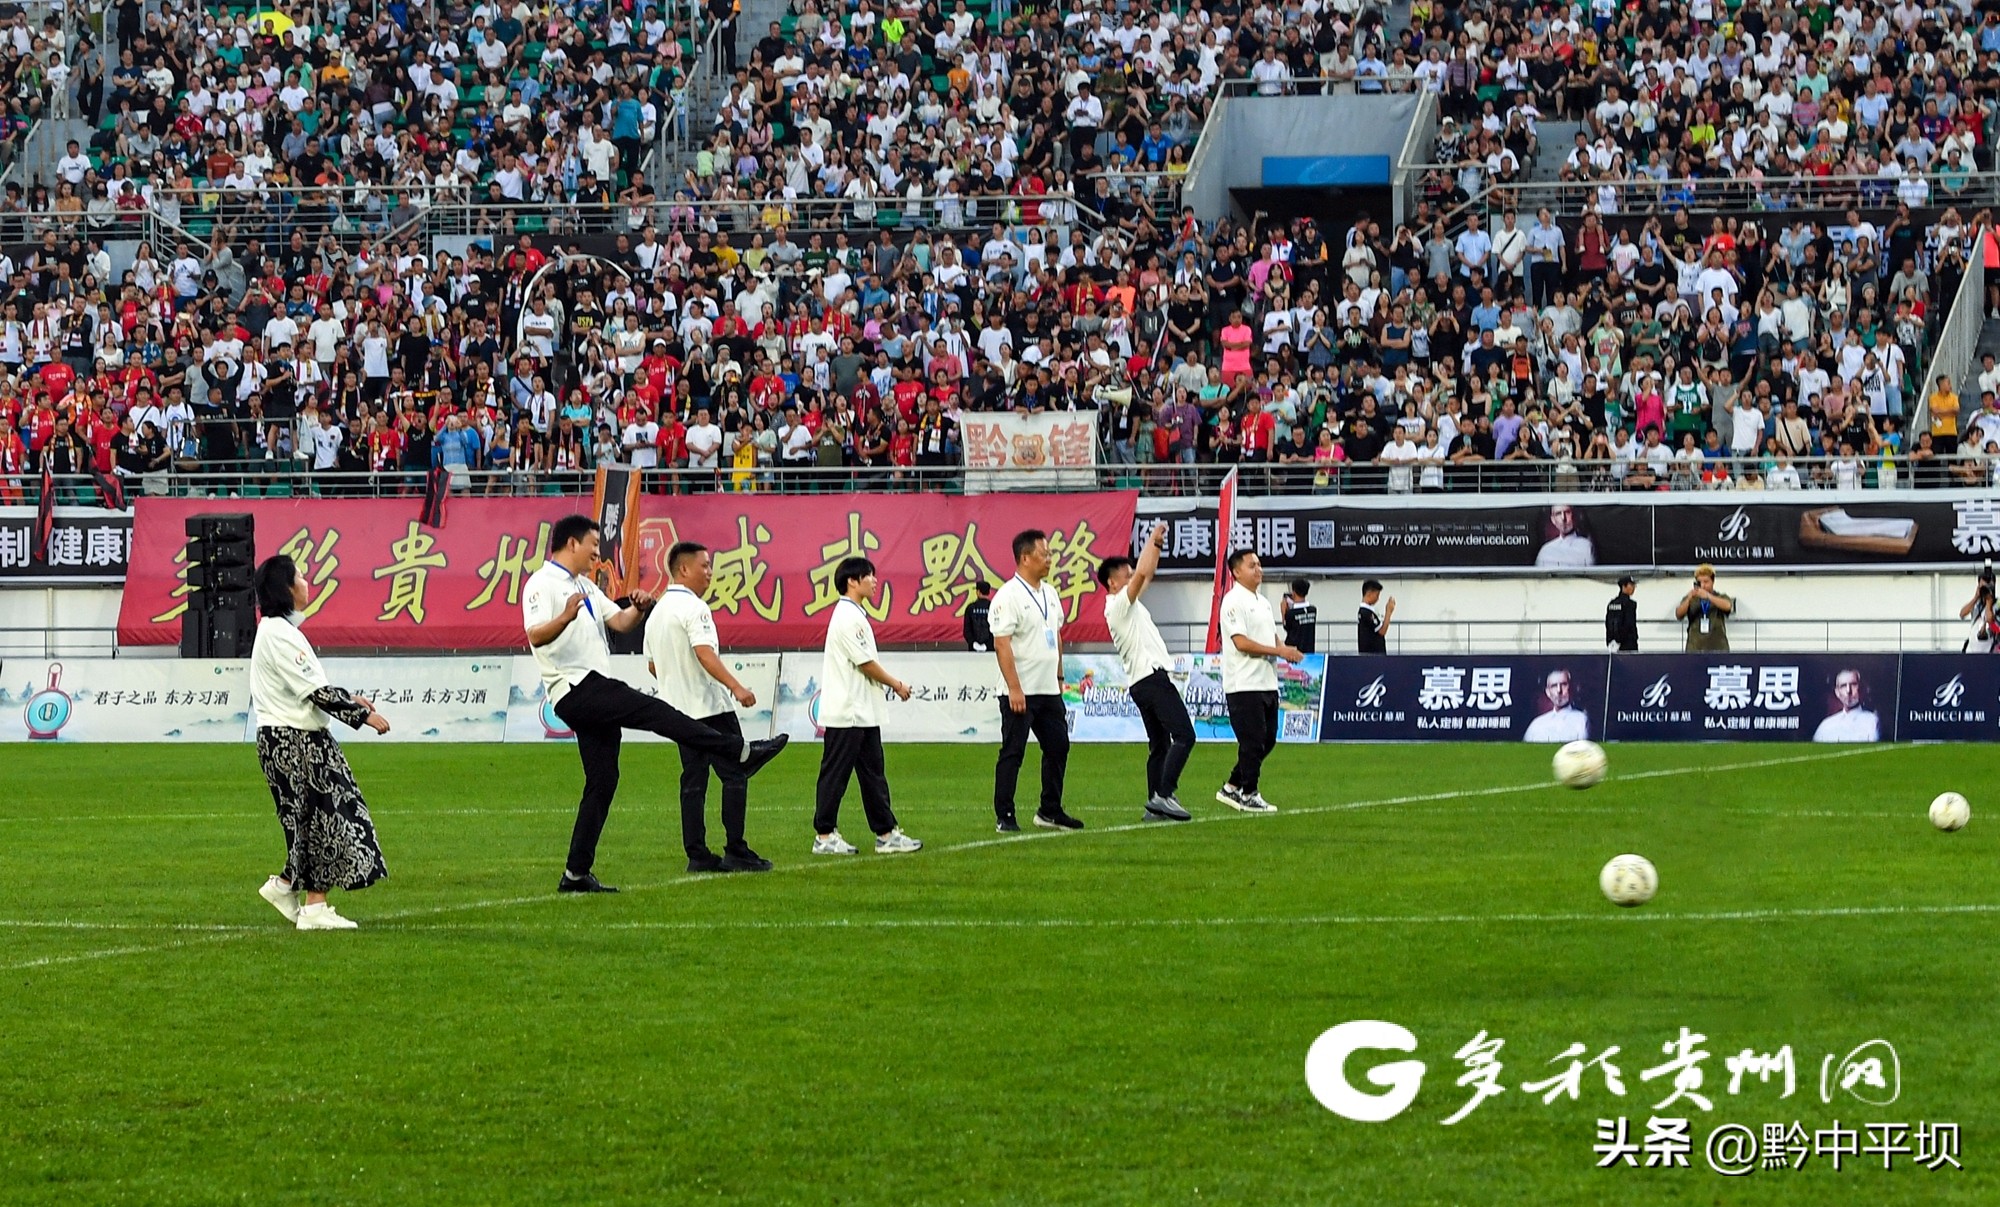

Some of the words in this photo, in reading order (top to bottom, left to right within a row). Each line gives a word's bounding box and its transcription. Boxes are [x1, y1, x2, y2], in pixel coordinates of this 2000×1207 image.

[966, 422, 1092, 467] 黔锋
[47, 525, 132, 568] 健康
[1359, 534, 1380, 546] 400
[1382, 534, 1401, 546] 777
[1404, 534, 1430, 546] 0077
[1436, 534, 1529, 547] www.derucci.com
[1695, 546, 1749, 558] DeRUCCI
[1418, 666, 1513, 711] 慕思
[1703, 665, 1802, 711] 慕思
[95, 690, 157, 706] 君子之品
[165, 689, 230, 706] 东方习酒
[422, 688, 487, 704] 东方习酒
[1333, 711, 1383, 722] DeRUCCI
[1417, 716, 1463, 729] 私人定制
[1466, 716, 1511, 729] 健康睡眠
[1617, 711, 1668, 722] DeRUCCI
[1704, 716, 1751, 730] 私人定制
[1753, 716, 1800, 730] 健康睡眠
[1909, 710, 1962, 722] DeRUCCI
